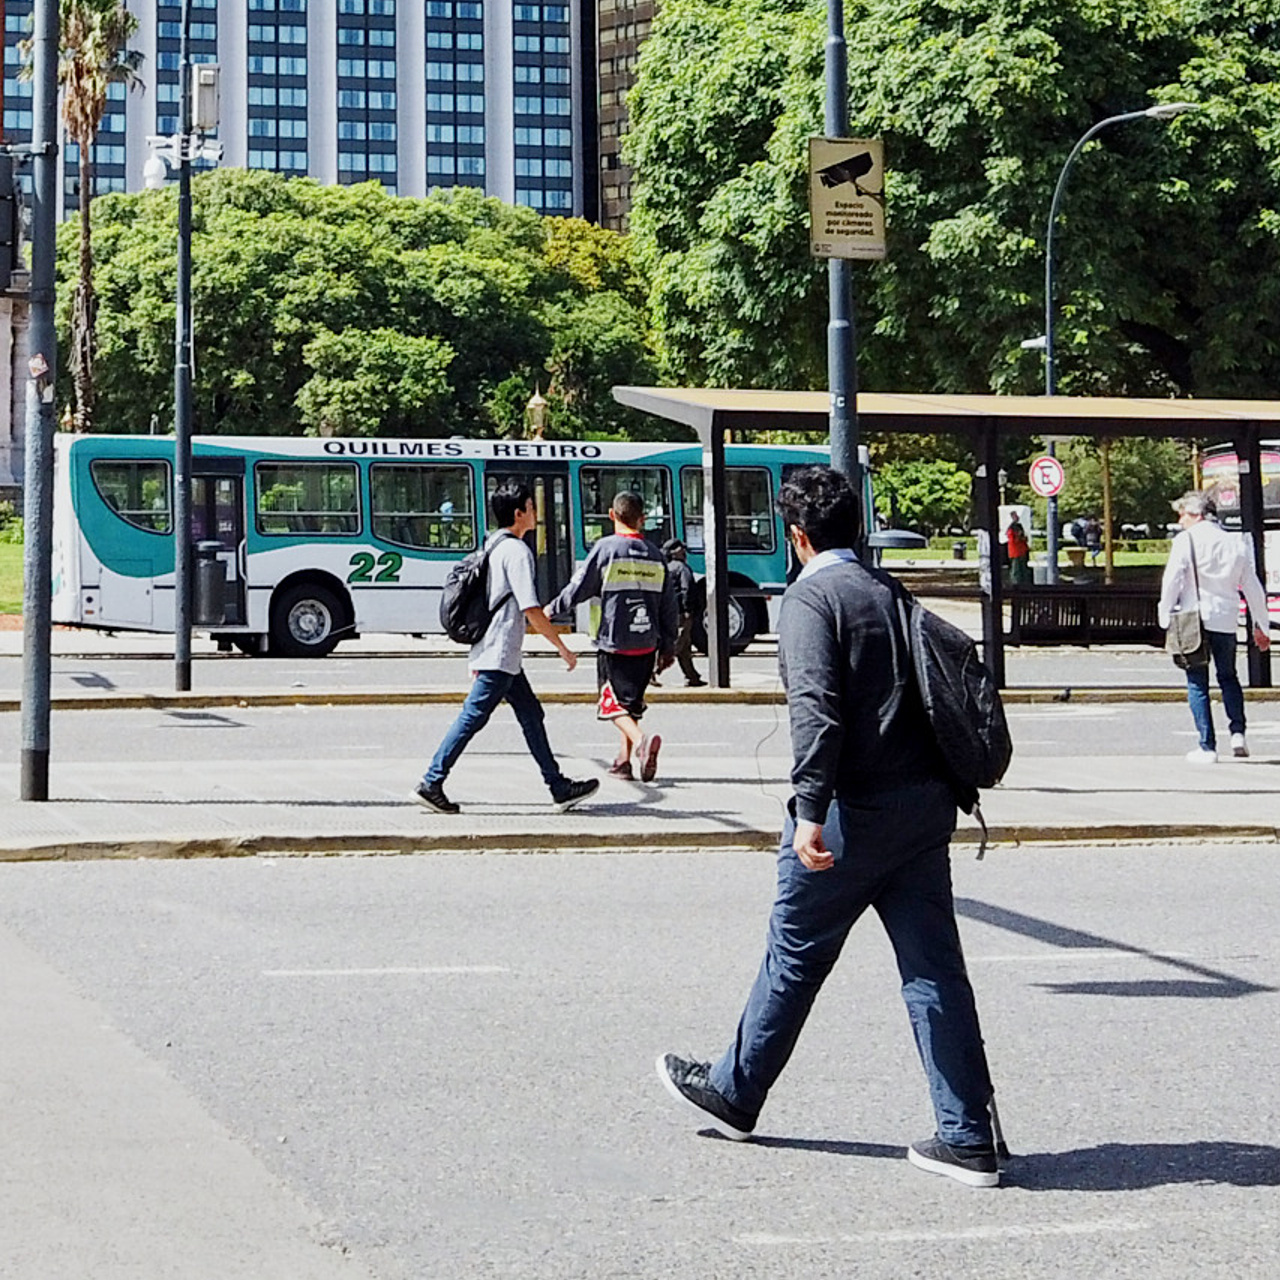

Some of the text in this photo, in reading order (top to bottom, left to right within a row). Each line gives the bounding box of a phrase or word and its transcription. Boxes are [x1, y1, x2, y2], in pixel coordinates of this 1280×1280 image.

[323, 441, 463, 457] QUILMES
[493, 444, 602, 458] RETIRO
[347, 552, 402, 584] 22
